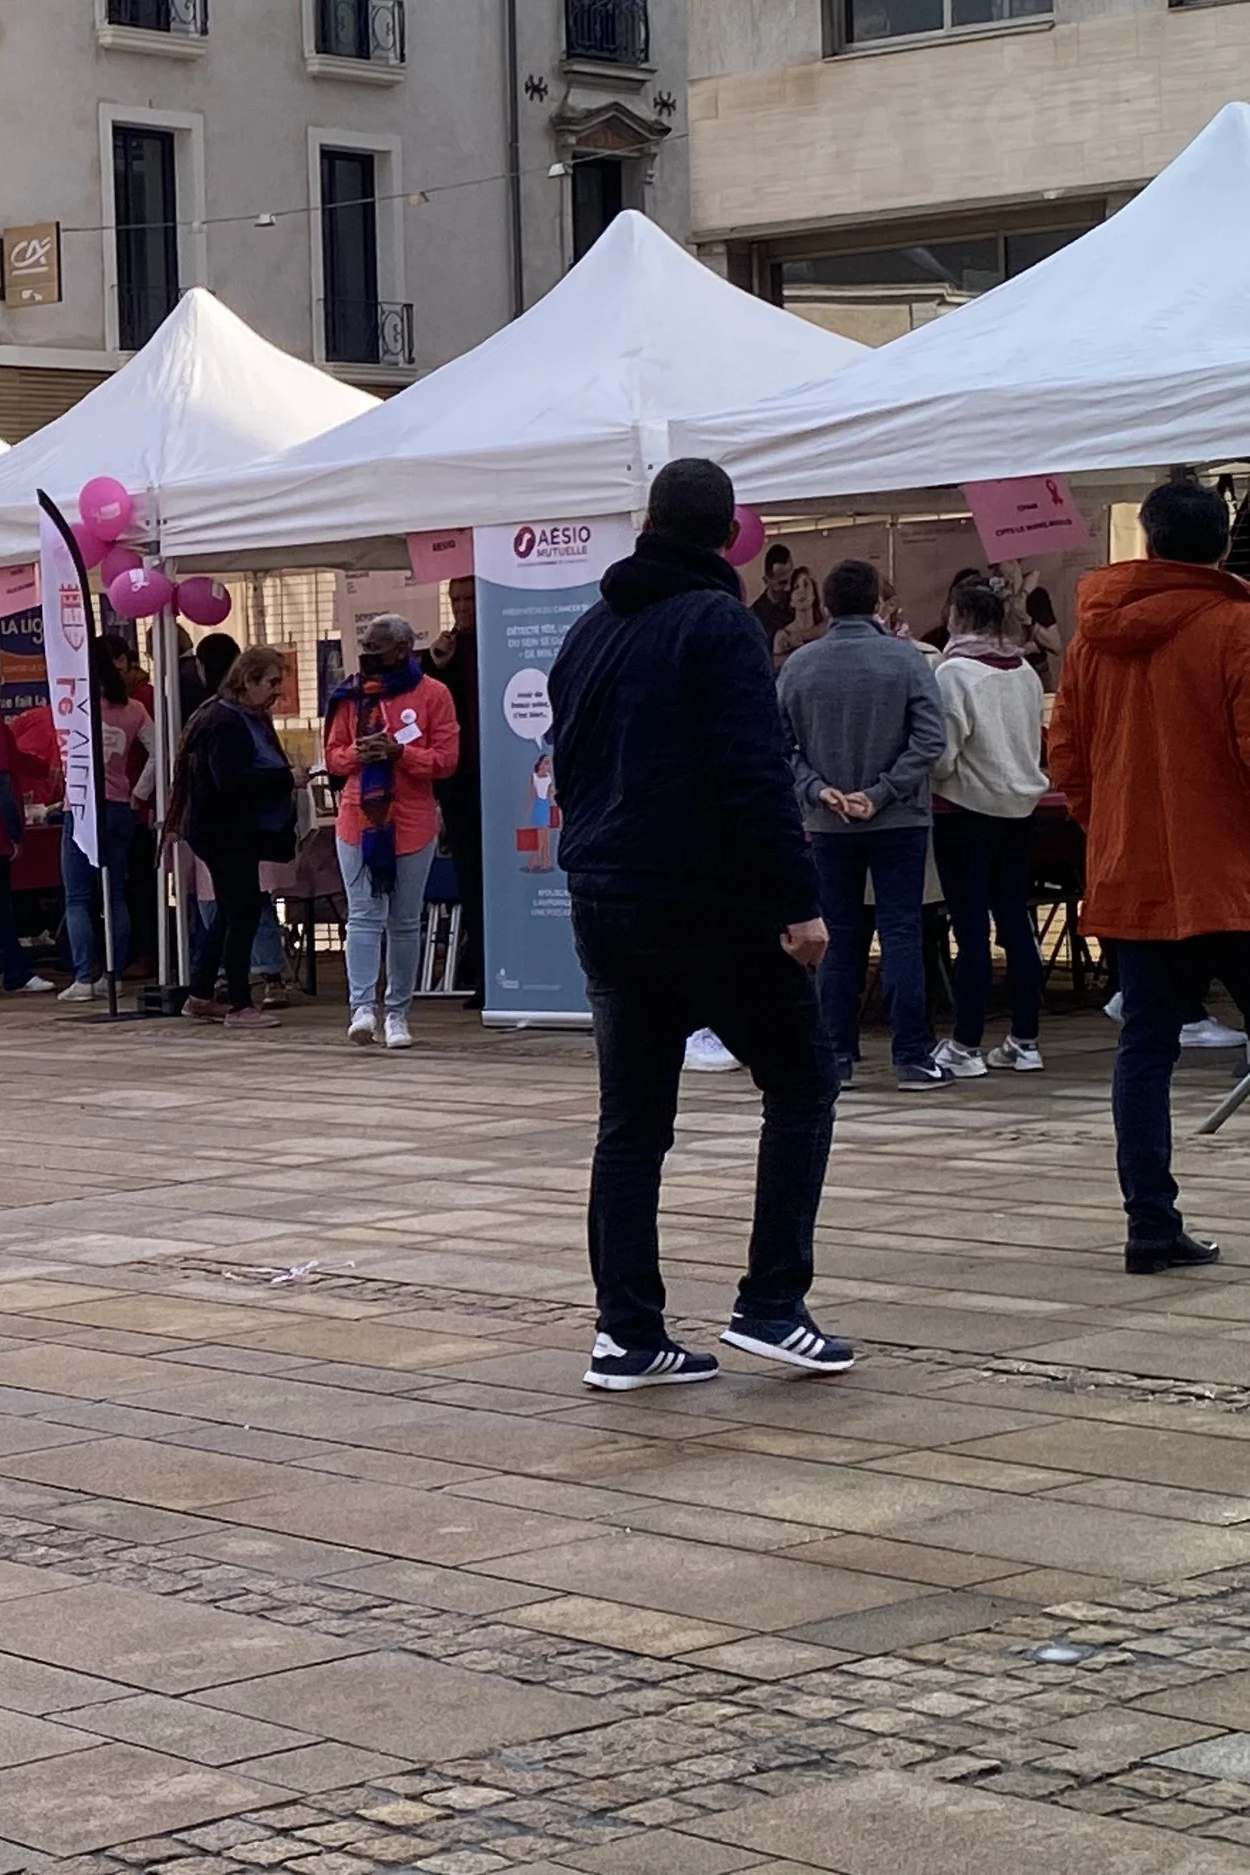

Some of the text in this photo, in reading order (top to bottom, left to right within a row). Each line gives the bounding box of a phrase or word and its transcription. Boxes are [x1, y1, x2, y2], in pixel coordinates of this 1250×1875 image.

[536, 545, 588, 558] MUTUELLE
[1, 618, 43, 644] LA LIG
